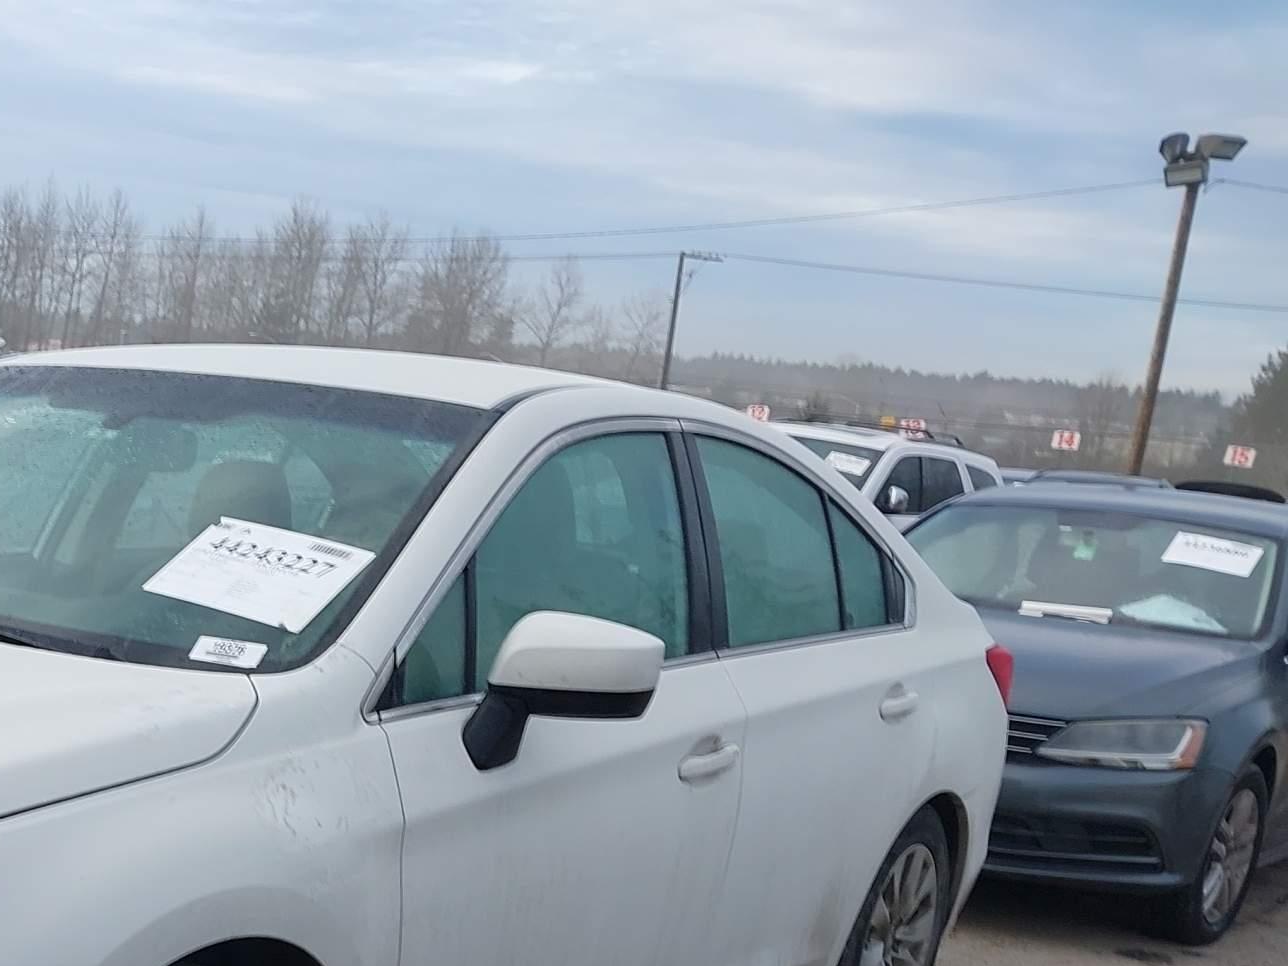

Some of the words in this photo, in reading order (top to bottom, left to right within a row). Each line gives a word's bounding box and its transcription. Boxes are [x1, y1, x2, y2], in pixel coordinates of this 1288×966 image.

[1058, 431, 1075, 449] 14
[1232, 447, 1250, 465] 15
[211, 537, 339, 578] 44243227
